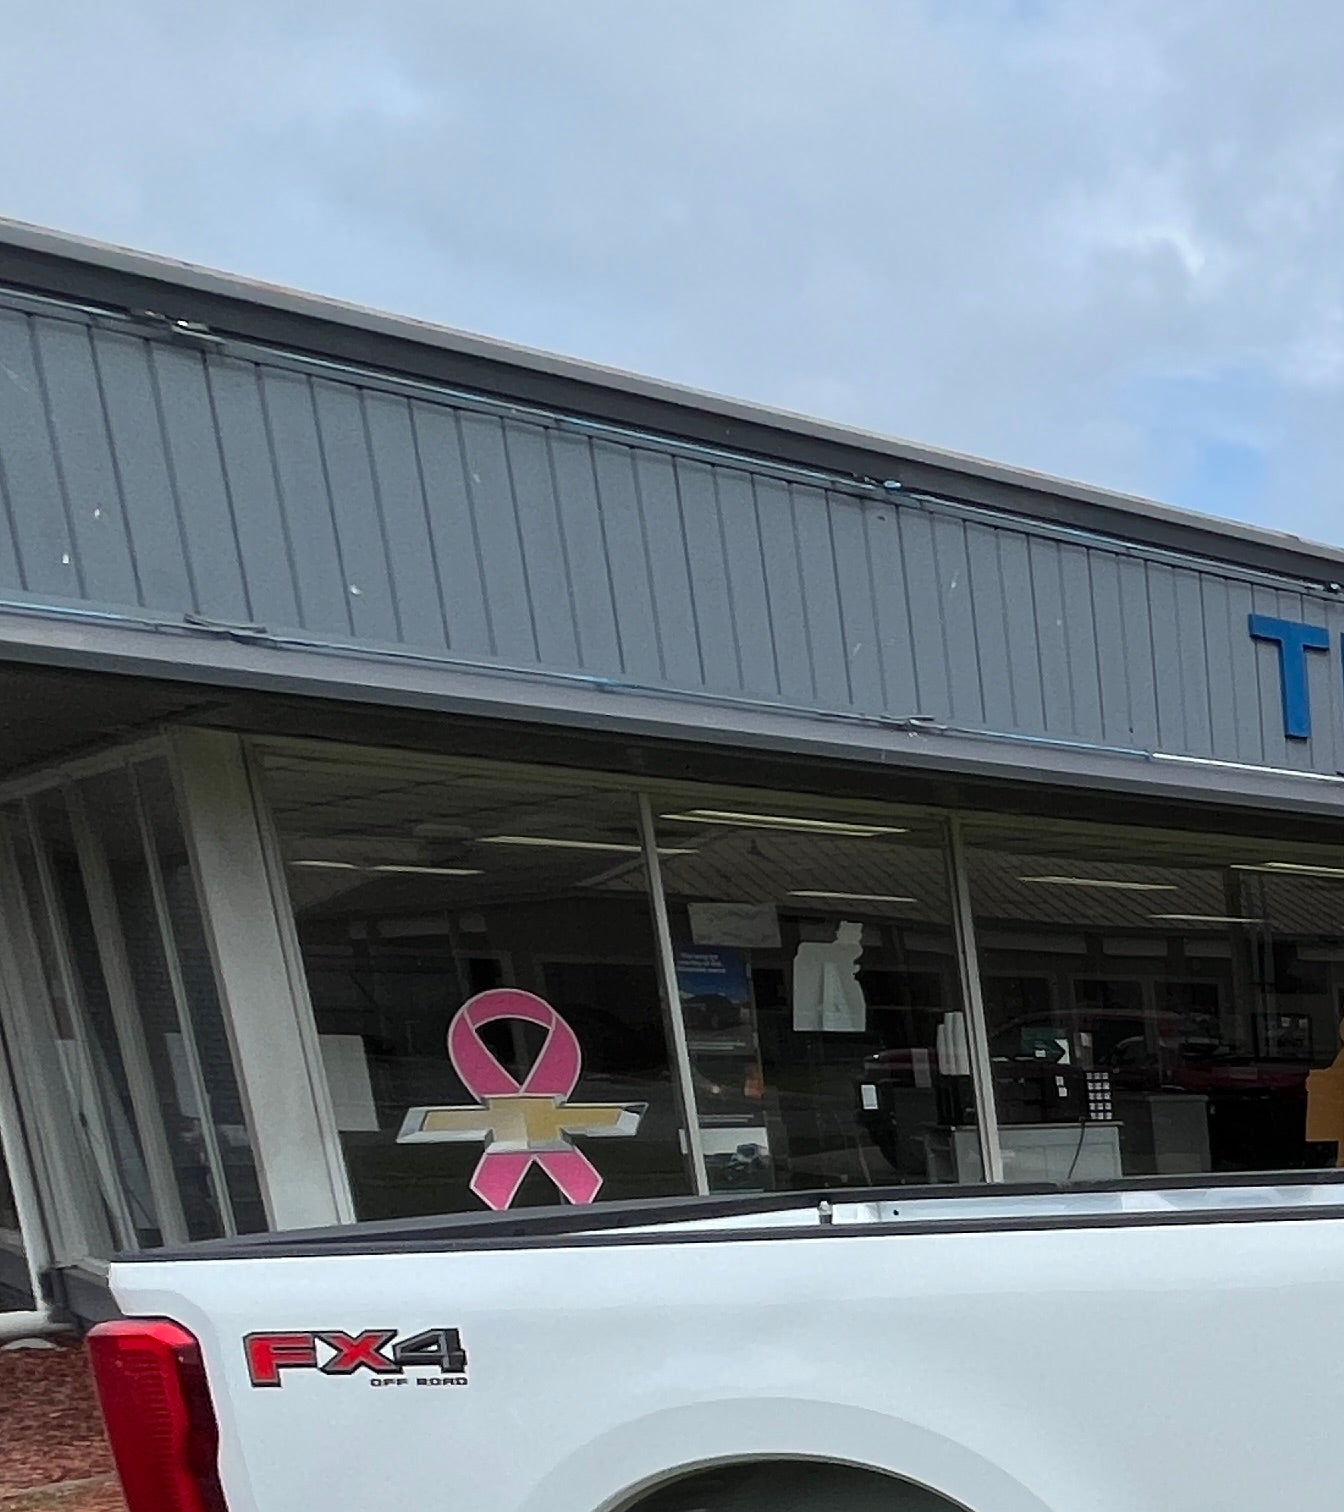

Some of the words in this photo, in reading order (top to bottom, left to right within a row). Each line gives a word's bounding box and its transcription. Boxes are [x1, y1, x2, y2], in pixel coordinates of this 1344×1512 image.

[243, 1328, 468, 1388] FX4
[370, 1378, 408, 1387] OFF
[416, 1377, 468, 1386] ROAD
